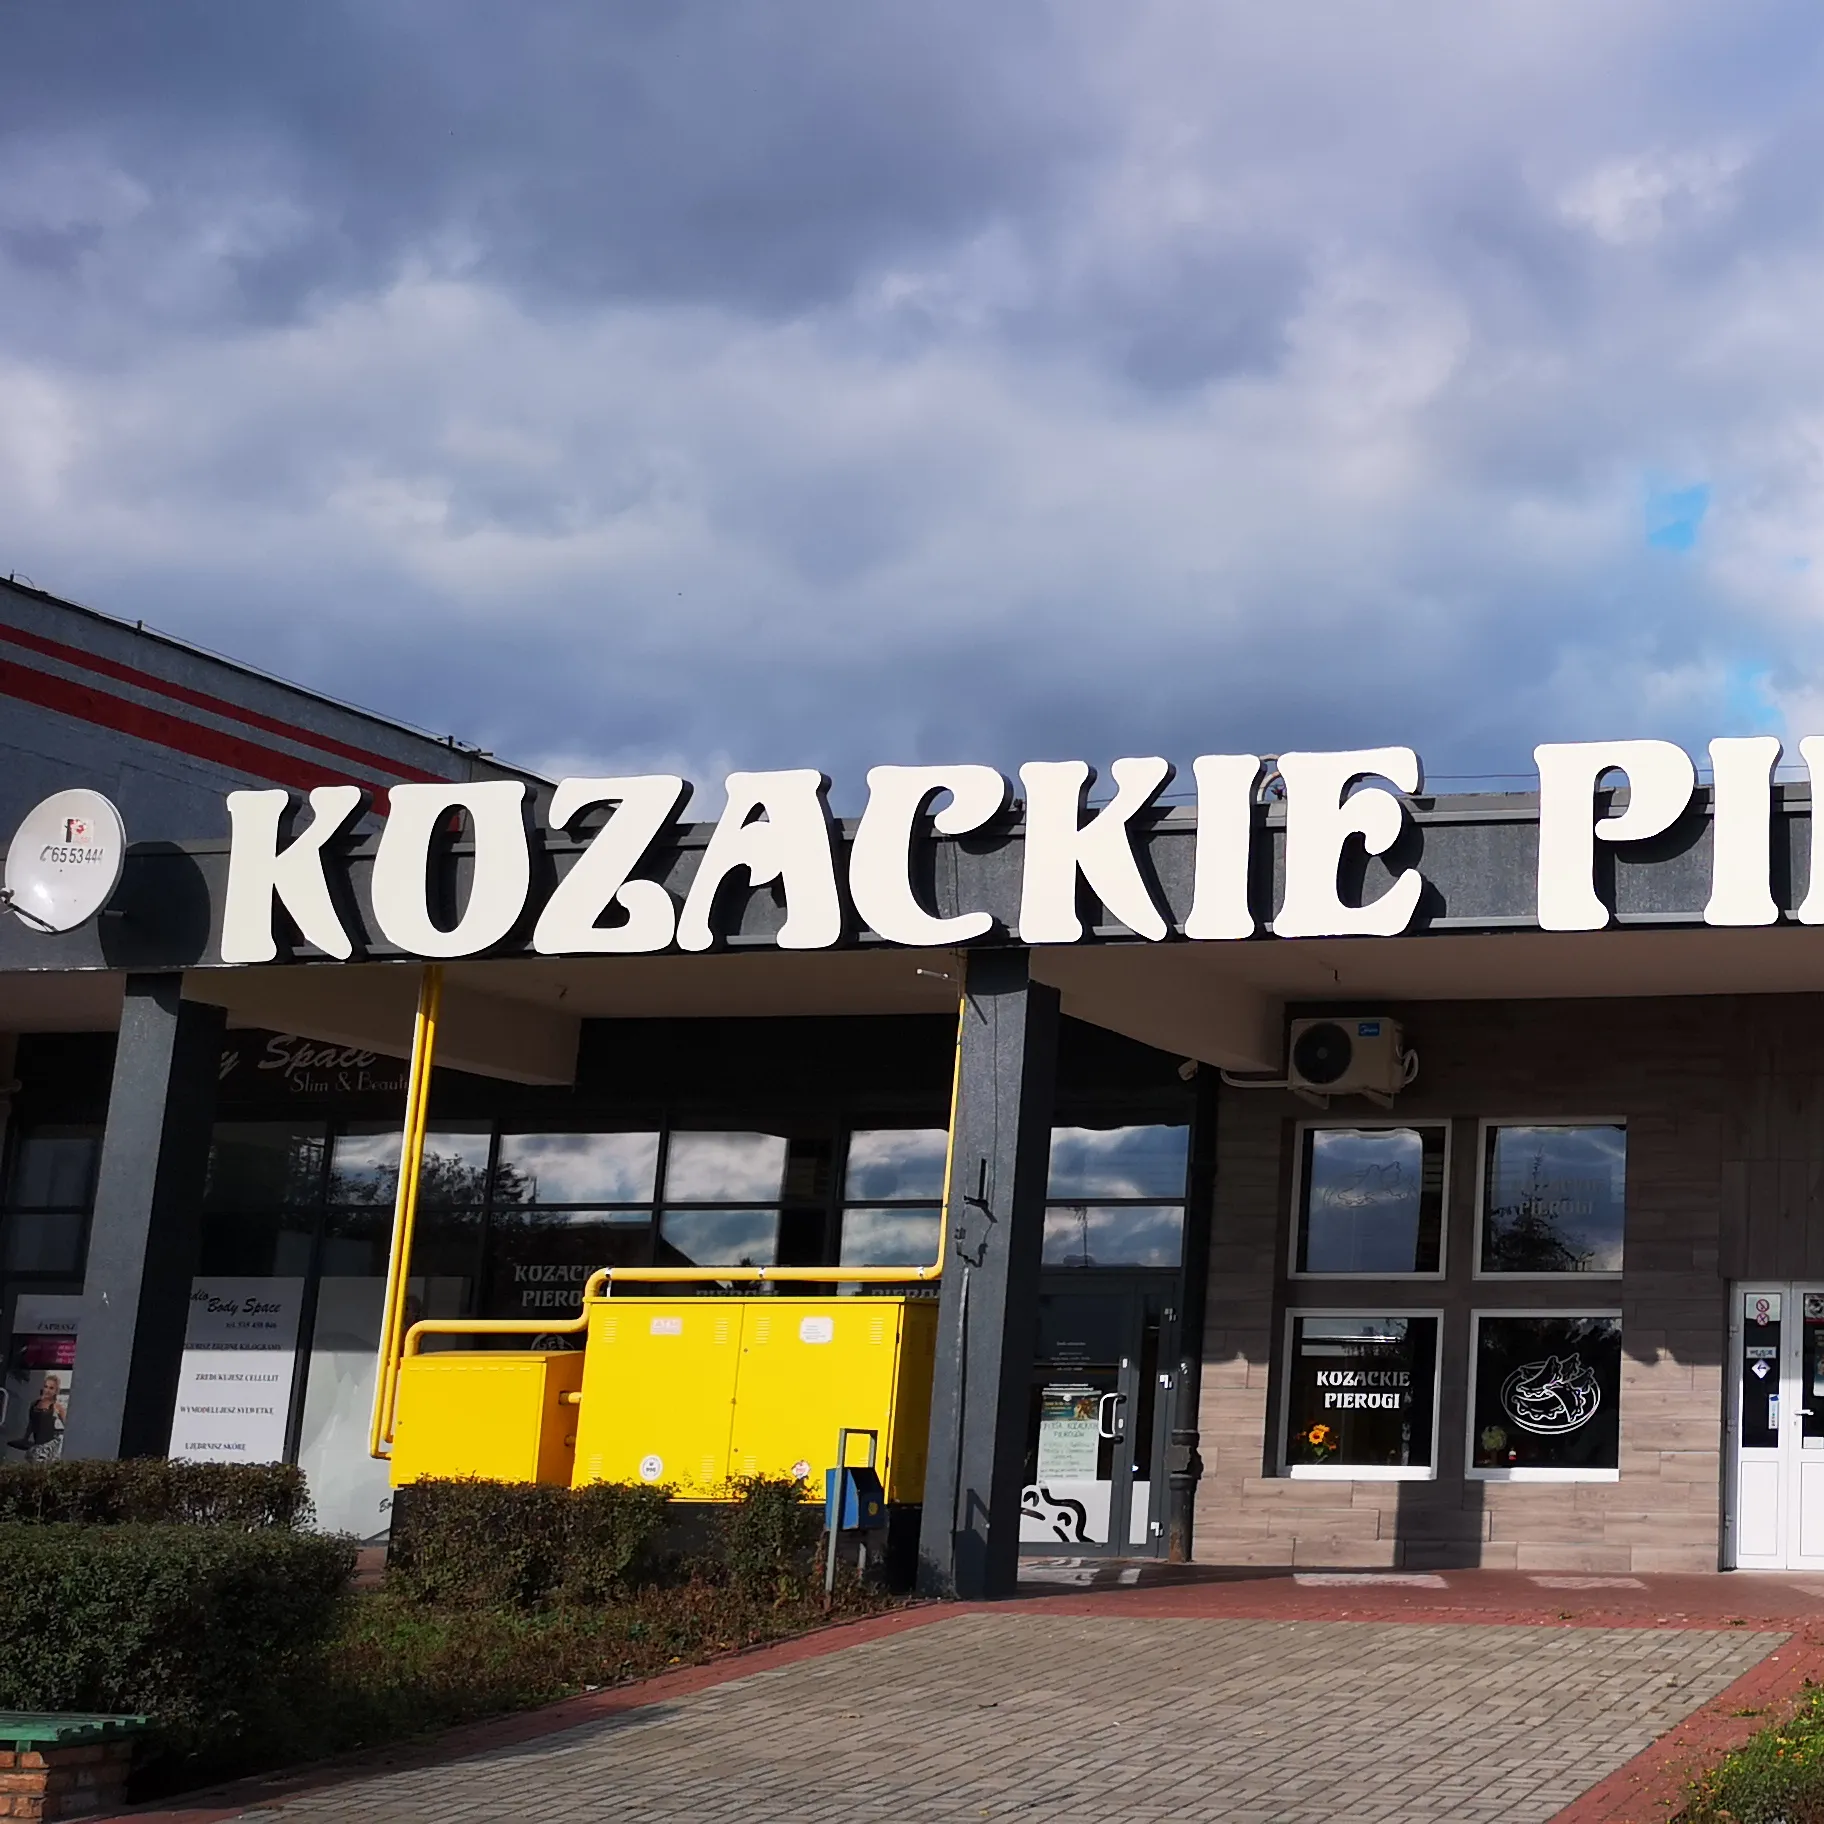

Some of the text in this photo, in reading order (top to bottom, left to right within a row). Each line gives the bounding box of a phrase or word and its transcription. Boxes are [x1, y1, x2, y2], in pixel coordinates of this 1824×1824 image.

[221, 747, 1422, 963] KOZACKIE
[514, 1264, 604, 1282] KOZACK
[242, 1297, 282, 1316] Space
[522, 1290, 583, 1307] PIERO
[1316, 1371, 1410, 1387] KOZACKIE
[1324, 1392, 1400, 1409] PIEROGI
